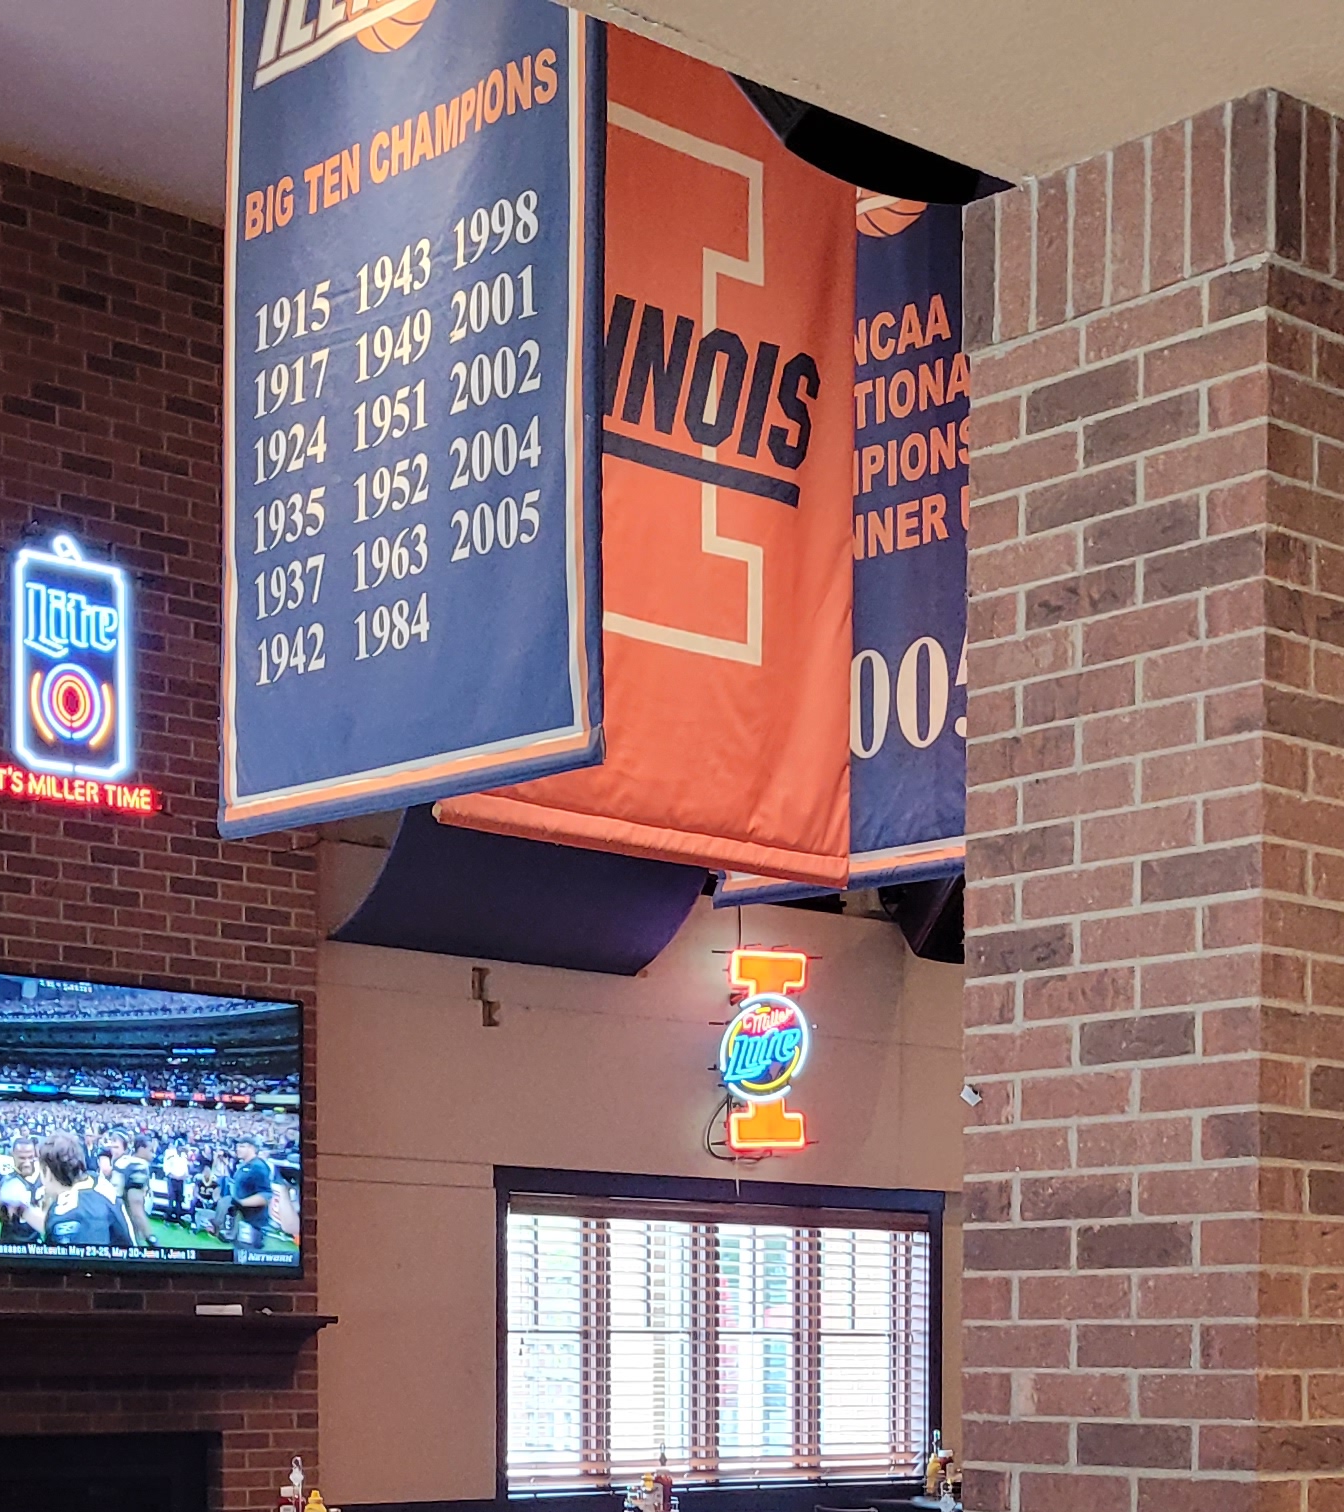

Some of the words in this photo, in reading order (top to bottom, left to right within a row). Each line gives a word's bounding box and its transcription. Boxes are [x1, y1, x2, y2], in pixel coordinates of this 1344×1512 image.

[244, 175, 295, 241] BIG
[304, 142, 360, 215] TEN
[369, 47, 559, 184] CHAMPIONS
[254, 279, 332, 354] 1915
[355, 239, 433, 316] 1943
[452, 189, 540, 272] 1998
[253, 350, 328, 419] 1917
[354, 311, 433, 385] 1949
[449, 265, 539, 345] 2001
[253, 421, 328, 486] 1924
[353, 380, 430, 454] 1951
[449, 339, 542, 417] 2002
[253, 486, 327, 555] 1935
[352, 452, 430, 524] 1952
[449, 416, 542, 492] 2004
[253, 554, 326, 620] 1937
[352, 524, 430, 594] 1963
[449, 489, 542, 563] 2005
[23, 582, 119, 658] Lite
[256, 622, 327, 686] 1942
[353, 593, 431, 662] 1984
[850, 636, 968, 760] 00
[27, 772, 100, 804] MILLER
[104, 783, 152, 811] TIME
[742, 1007, 795, 1034] Miller
[68, 1245, 85, 1258] May
[112, 1246, 127, 1259] May
[167, 1248, 186, 1260] June
[247, 1252, 294, 1264] NETWORK
